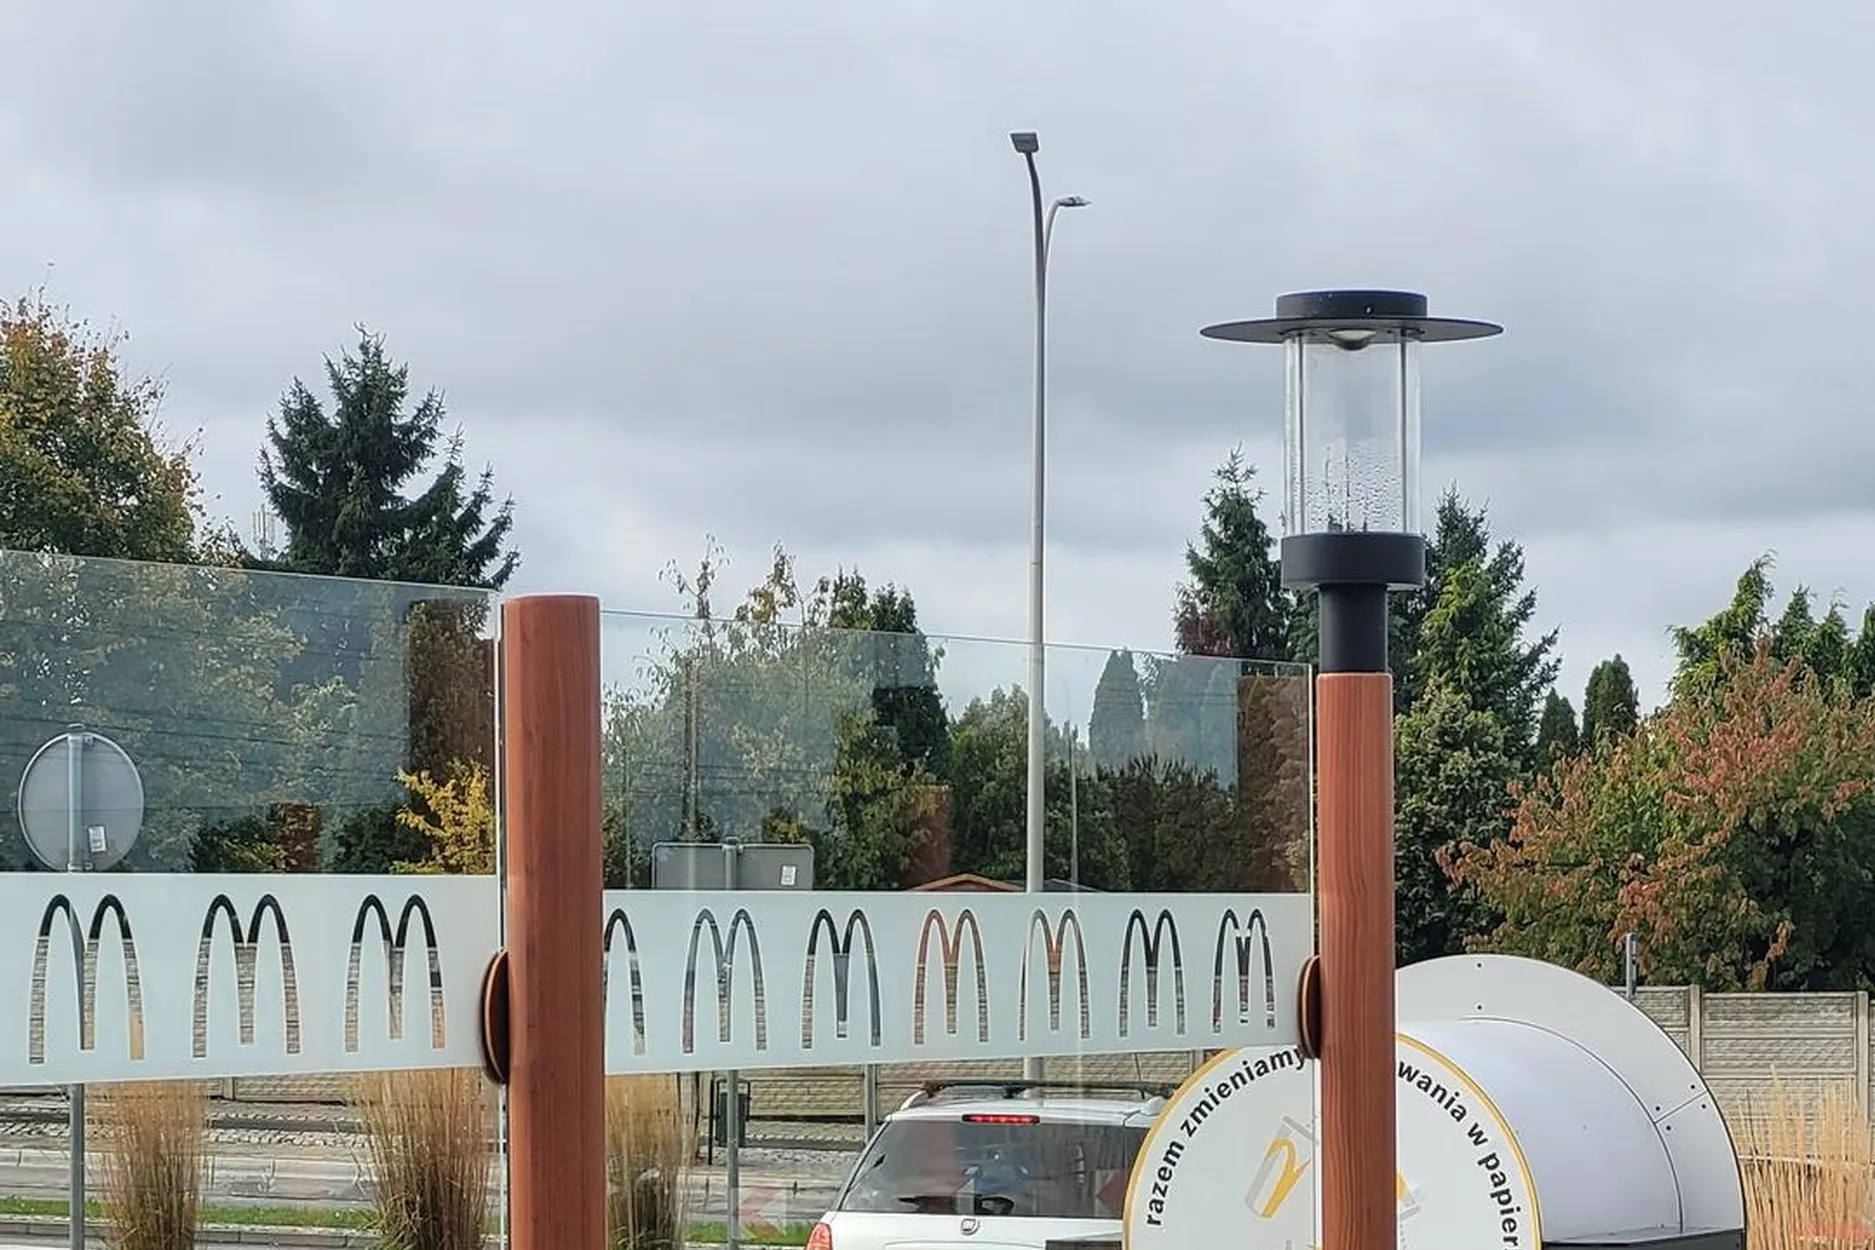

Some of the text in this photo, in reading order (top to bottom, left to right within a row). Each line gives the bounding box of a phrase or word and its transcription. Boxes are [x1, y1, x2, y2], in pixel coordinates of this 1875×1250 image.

[1147, 1140, 1185, 1226] razem
[1180, 1049, 1305, 1137] zmieniamy
[1397, 1061, 1467, 1122] wania
[1467, 1123, 1488, 1146] w
